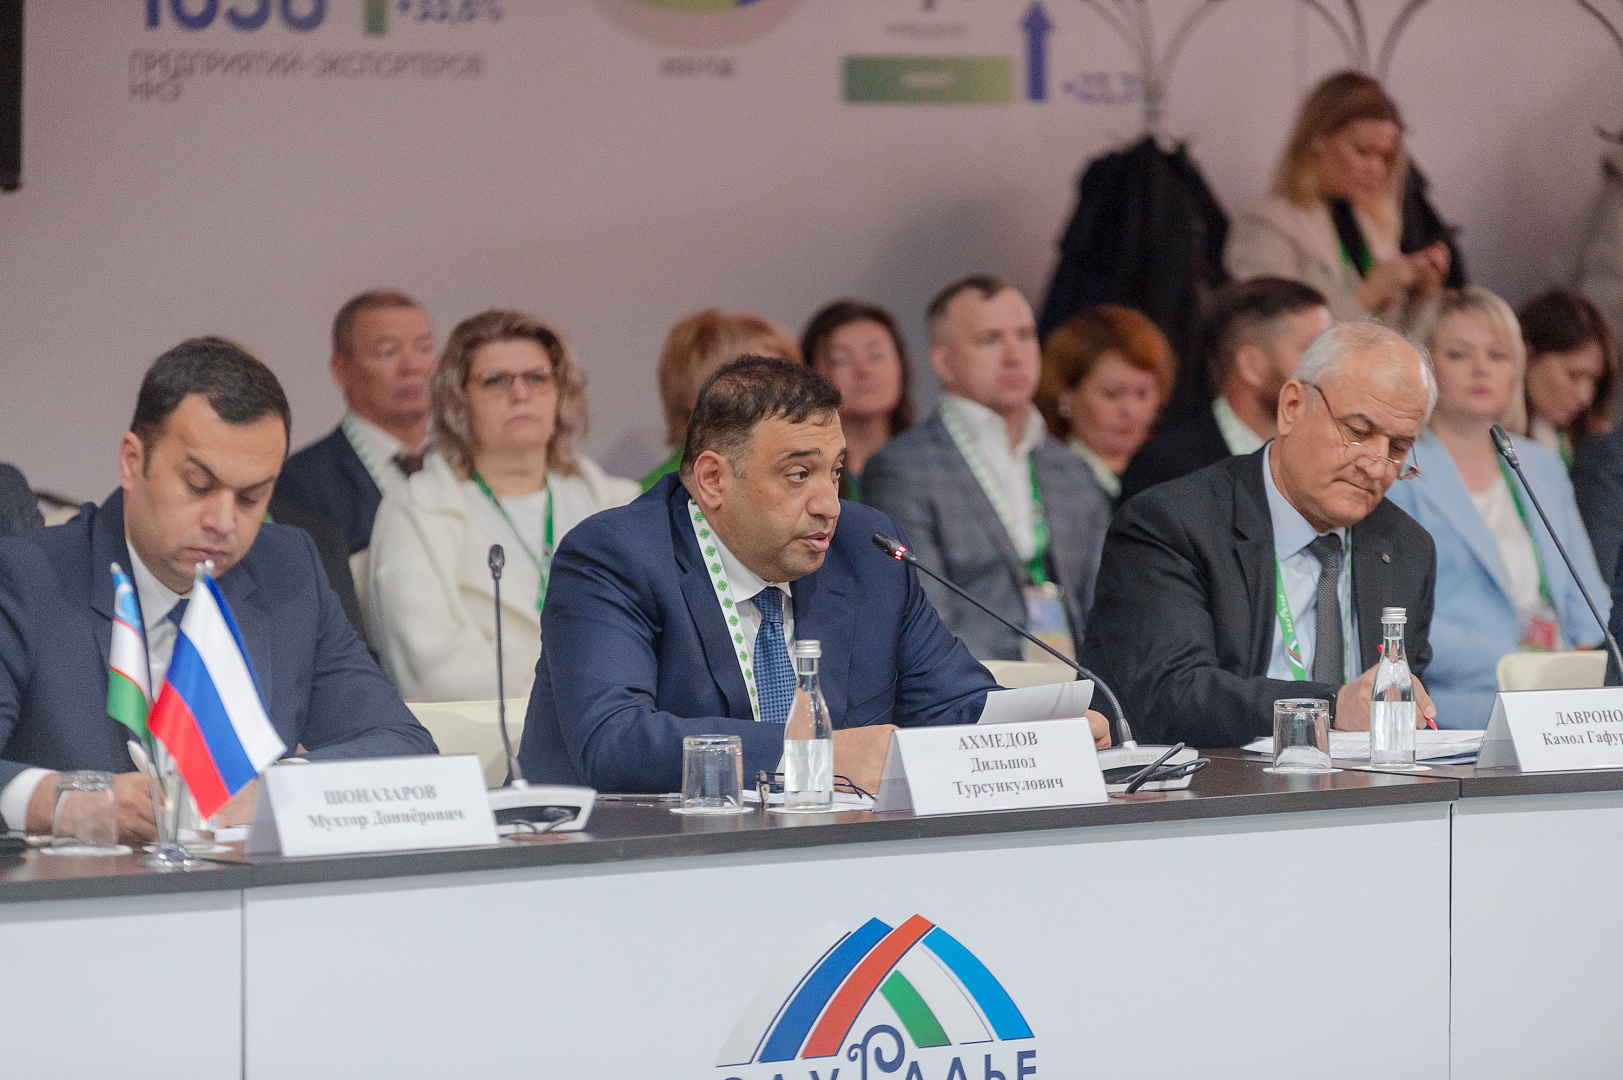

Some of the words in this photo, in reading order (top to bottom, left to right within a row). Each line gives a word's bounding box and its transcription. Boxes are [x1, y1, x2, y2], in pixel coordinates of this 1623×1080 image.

[958, 731, 1038, 750] АХМЕДОВ
[1541, 732, 1585, 746] Камол
[970, 757, 1037, 774] Дильшод
[1130, 753, 1157, 763] BOSCH
[323, 785, 438, 805] ШОНАЗАРОВ
[953, 778, 1064, 799] Турсункулович
[307, 813, 368, 832] Мухтор
